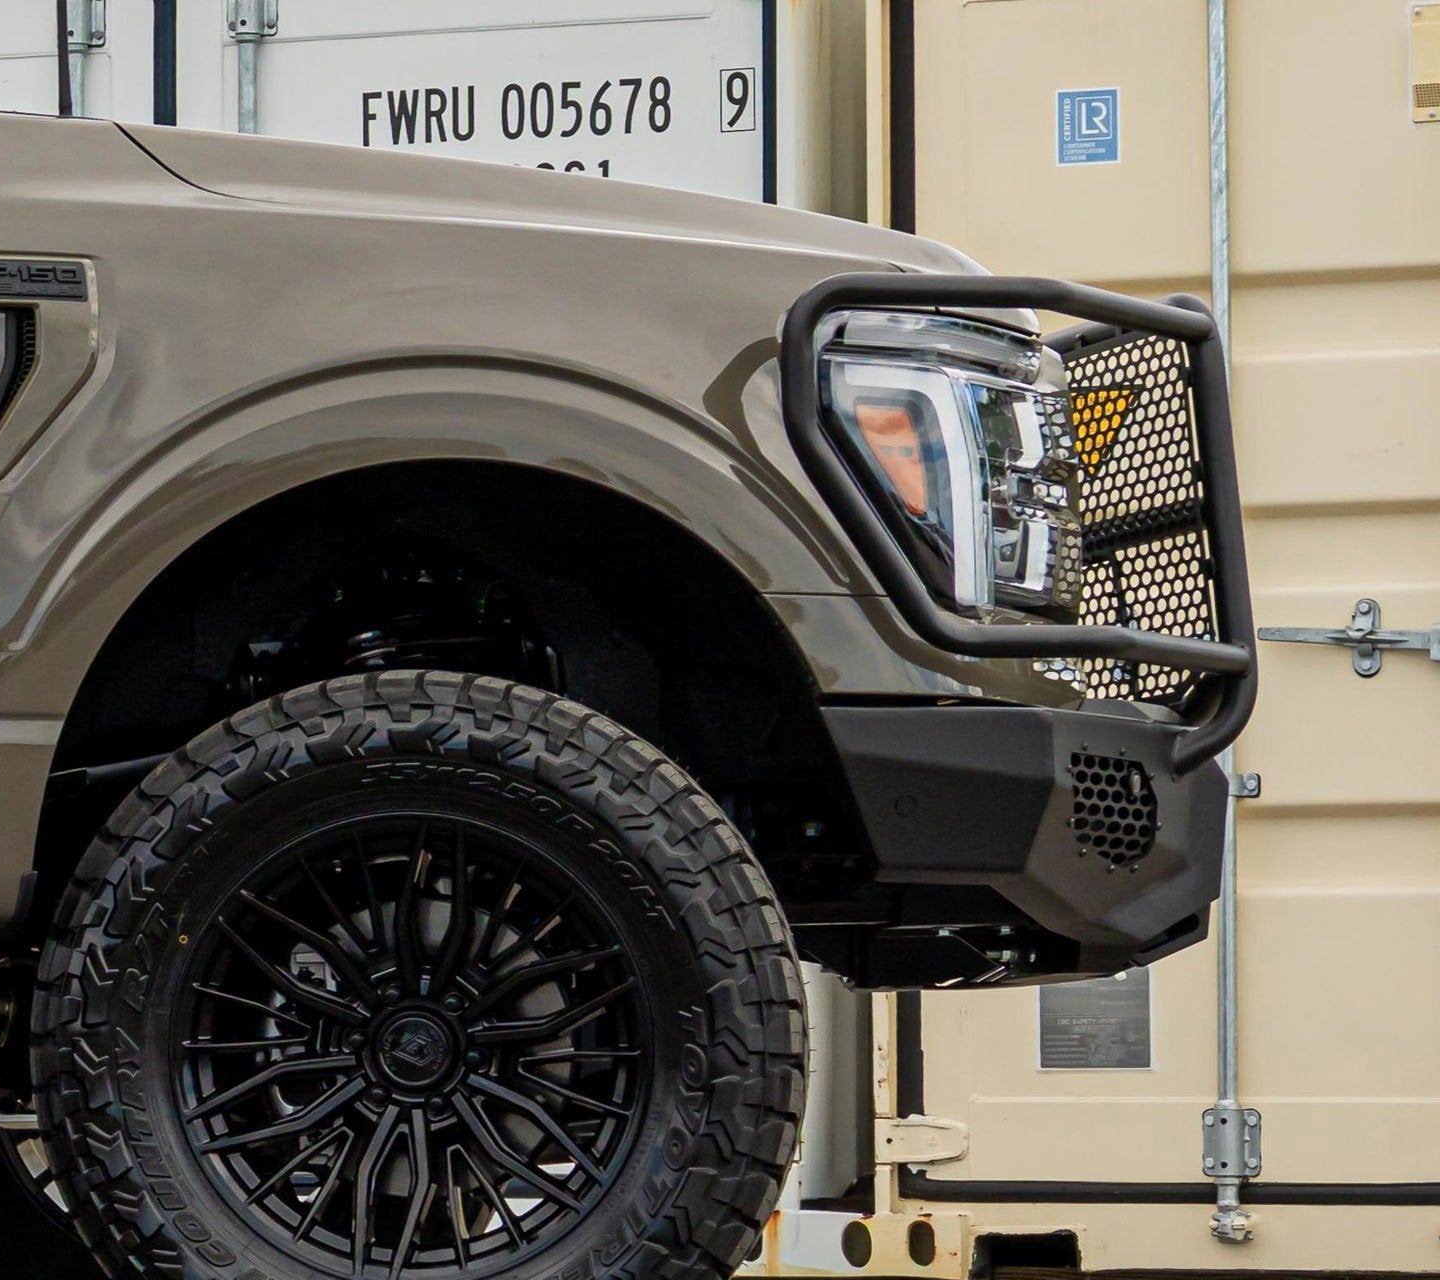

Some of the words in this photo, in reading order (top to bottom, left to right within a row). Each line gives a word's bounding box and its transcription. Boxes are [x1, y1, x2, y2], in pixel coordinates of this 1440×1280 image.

[362, 85, 475, 147] FWRU
[501, 76, 672, 139] 005678
[725, 71, 751, 128] 9
[1081, 101, 1109, 135] LR
[116, 1026, 233, 1269] COUNTRY
[664, 1005, 708, 1172] TOYO
